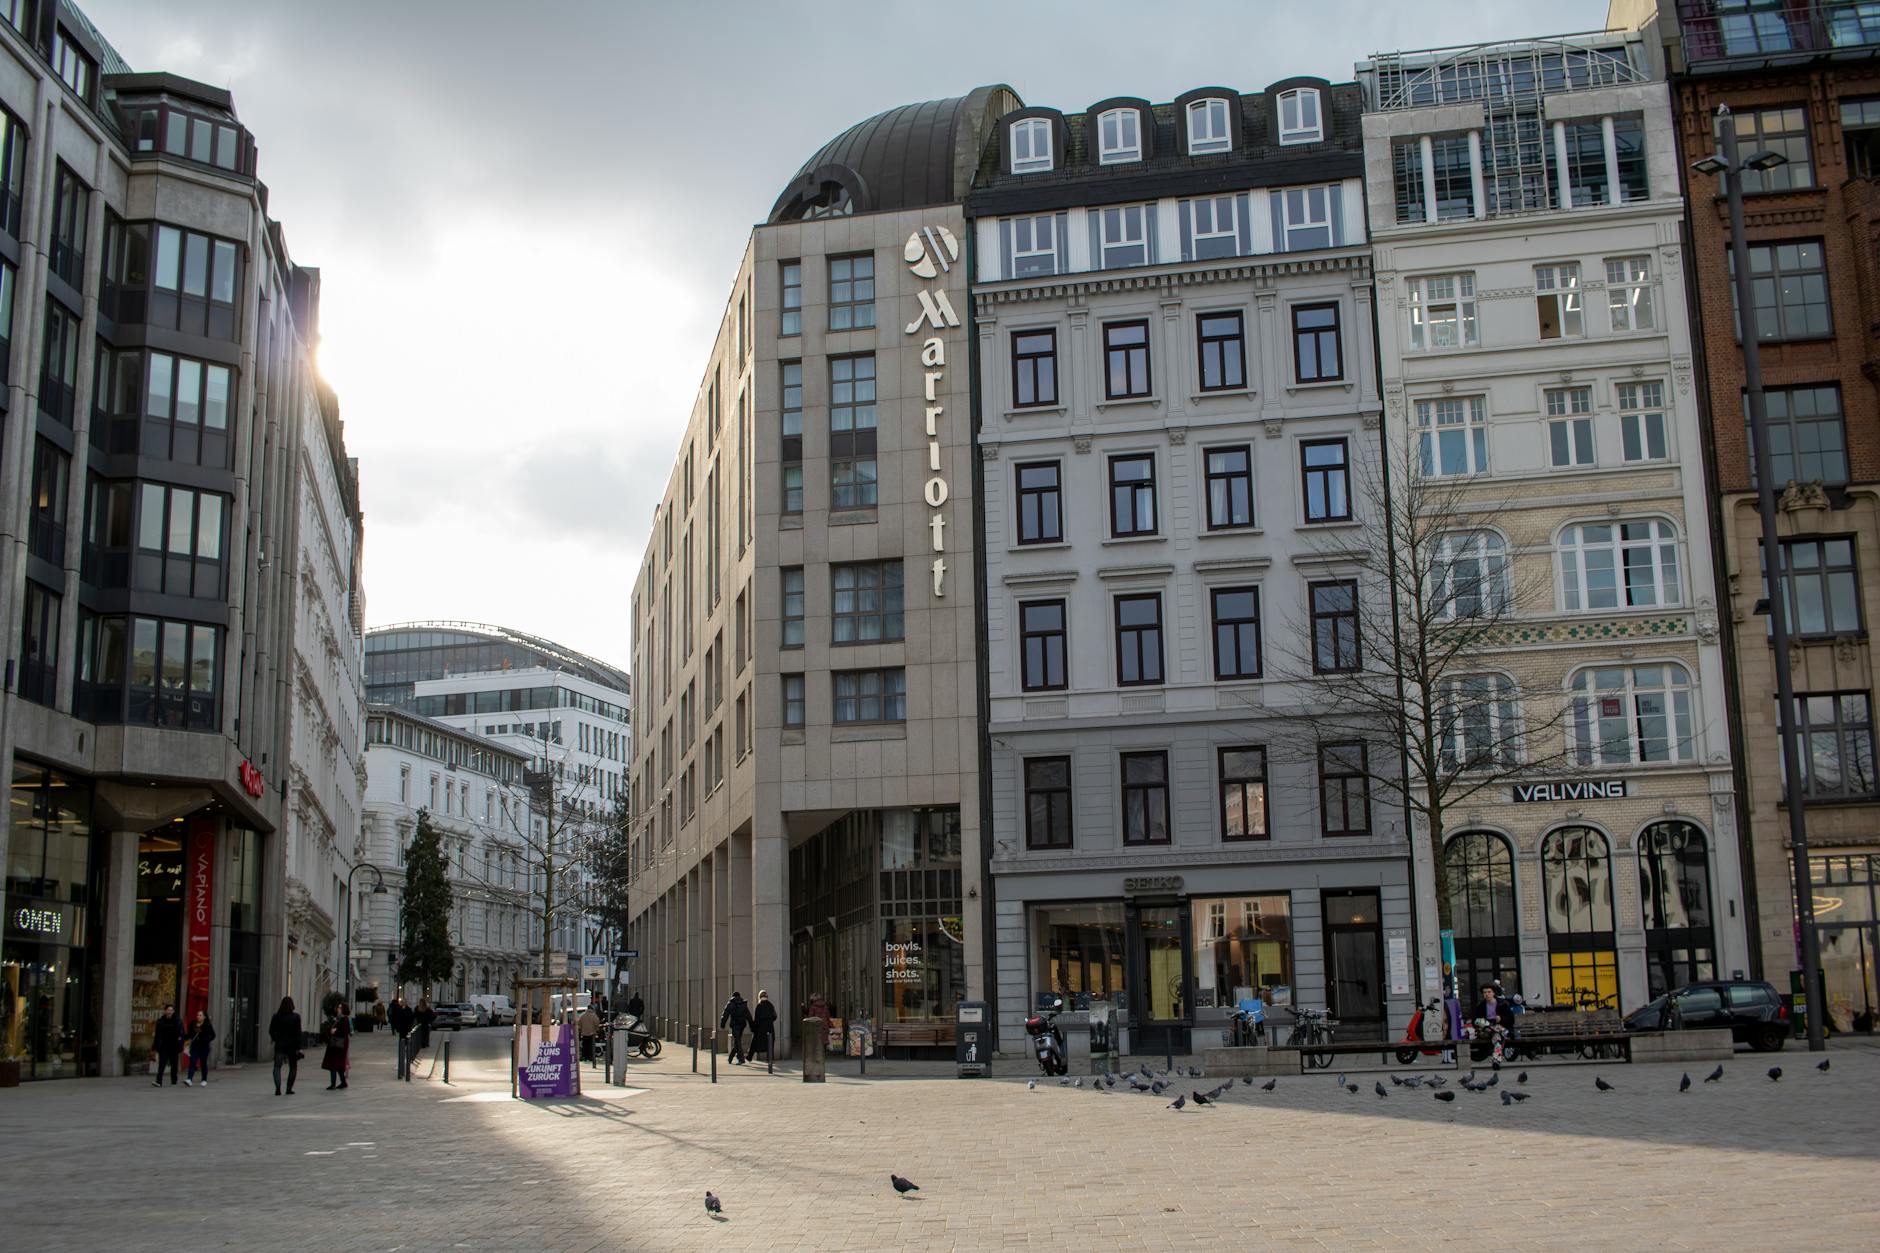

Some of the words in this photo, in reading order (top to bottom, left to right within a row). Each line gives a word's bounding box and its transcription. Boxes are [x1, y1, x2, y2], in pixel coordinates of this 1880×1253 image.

[904, 288, 960, 597] Marriott
[1517, 780, 1624, 802] VALIVING
[1124, 875, 1185, 893] SEIKO
[885, 941, 922, 951] bowls.
[884, 955, 921, 968] juices.
[885, 969, 920, 979] shots.
[543, 1047, 560, 1056] UNS
[525, 1063, 563, 1073] ZUKUNFT
[527, 1072, 561, 1081] ZURÜCK
